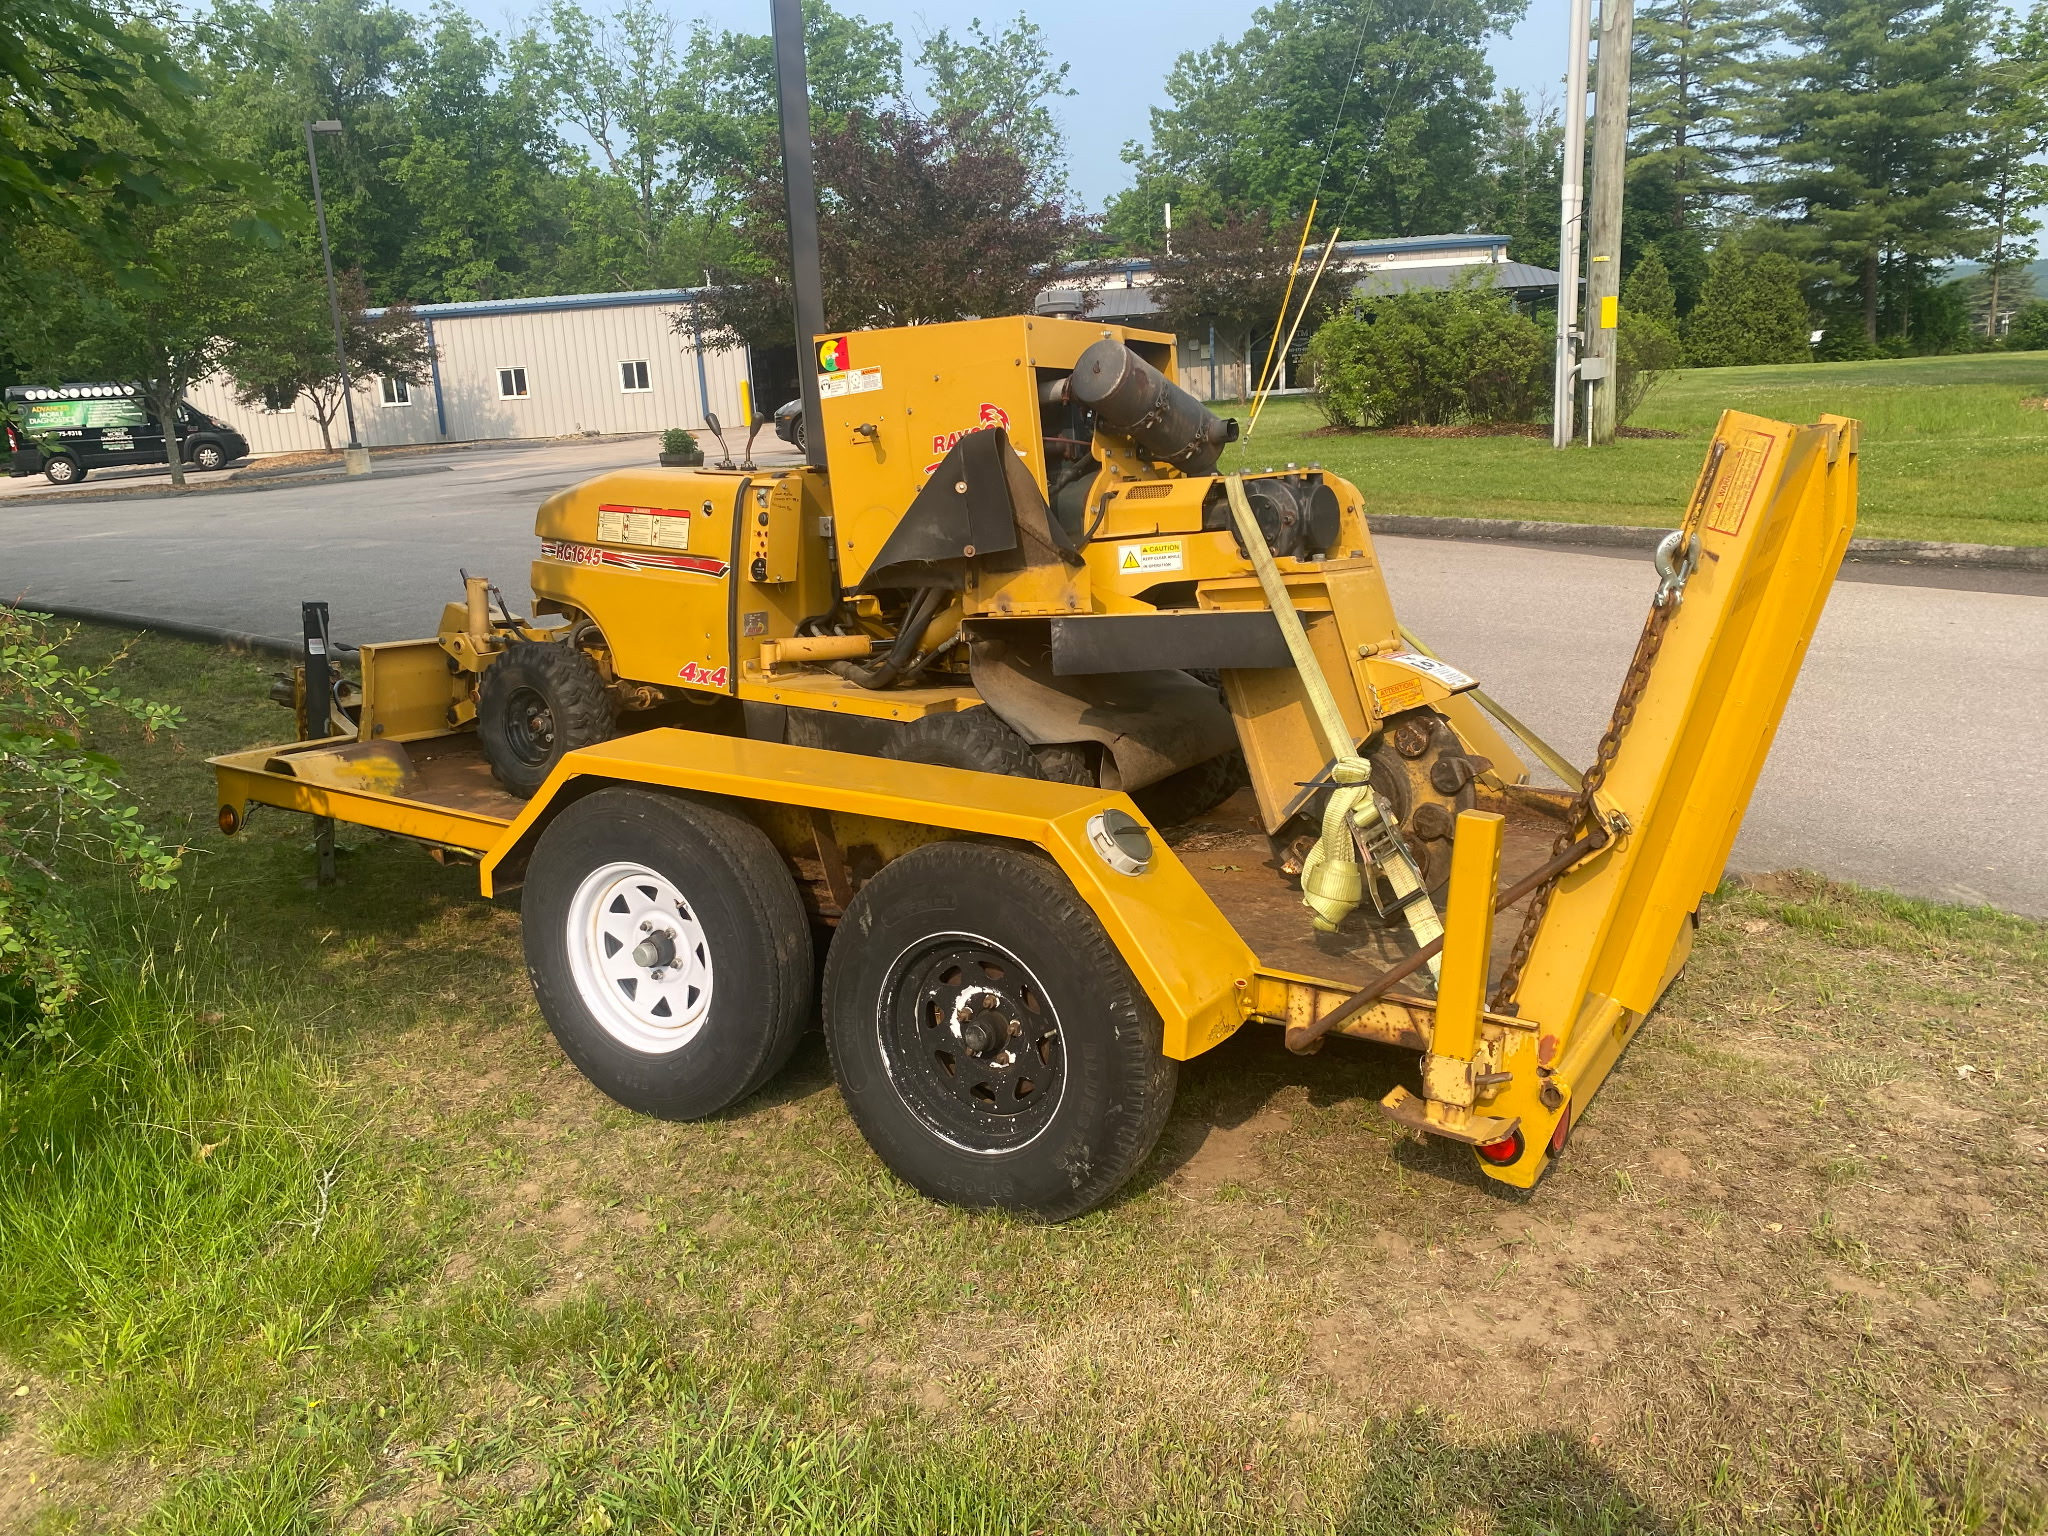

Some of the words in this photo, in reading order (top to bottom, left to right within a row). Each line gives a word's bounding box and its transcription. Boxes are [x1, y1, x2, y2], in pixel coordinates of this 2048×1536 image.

[32, 405, 70, 414] ADVANCED
[29, 415, 76, 425] DIAGNOSTICS
[555, 543, 602, 566] RG1645
[678, 661, 727, 688] 4x4
